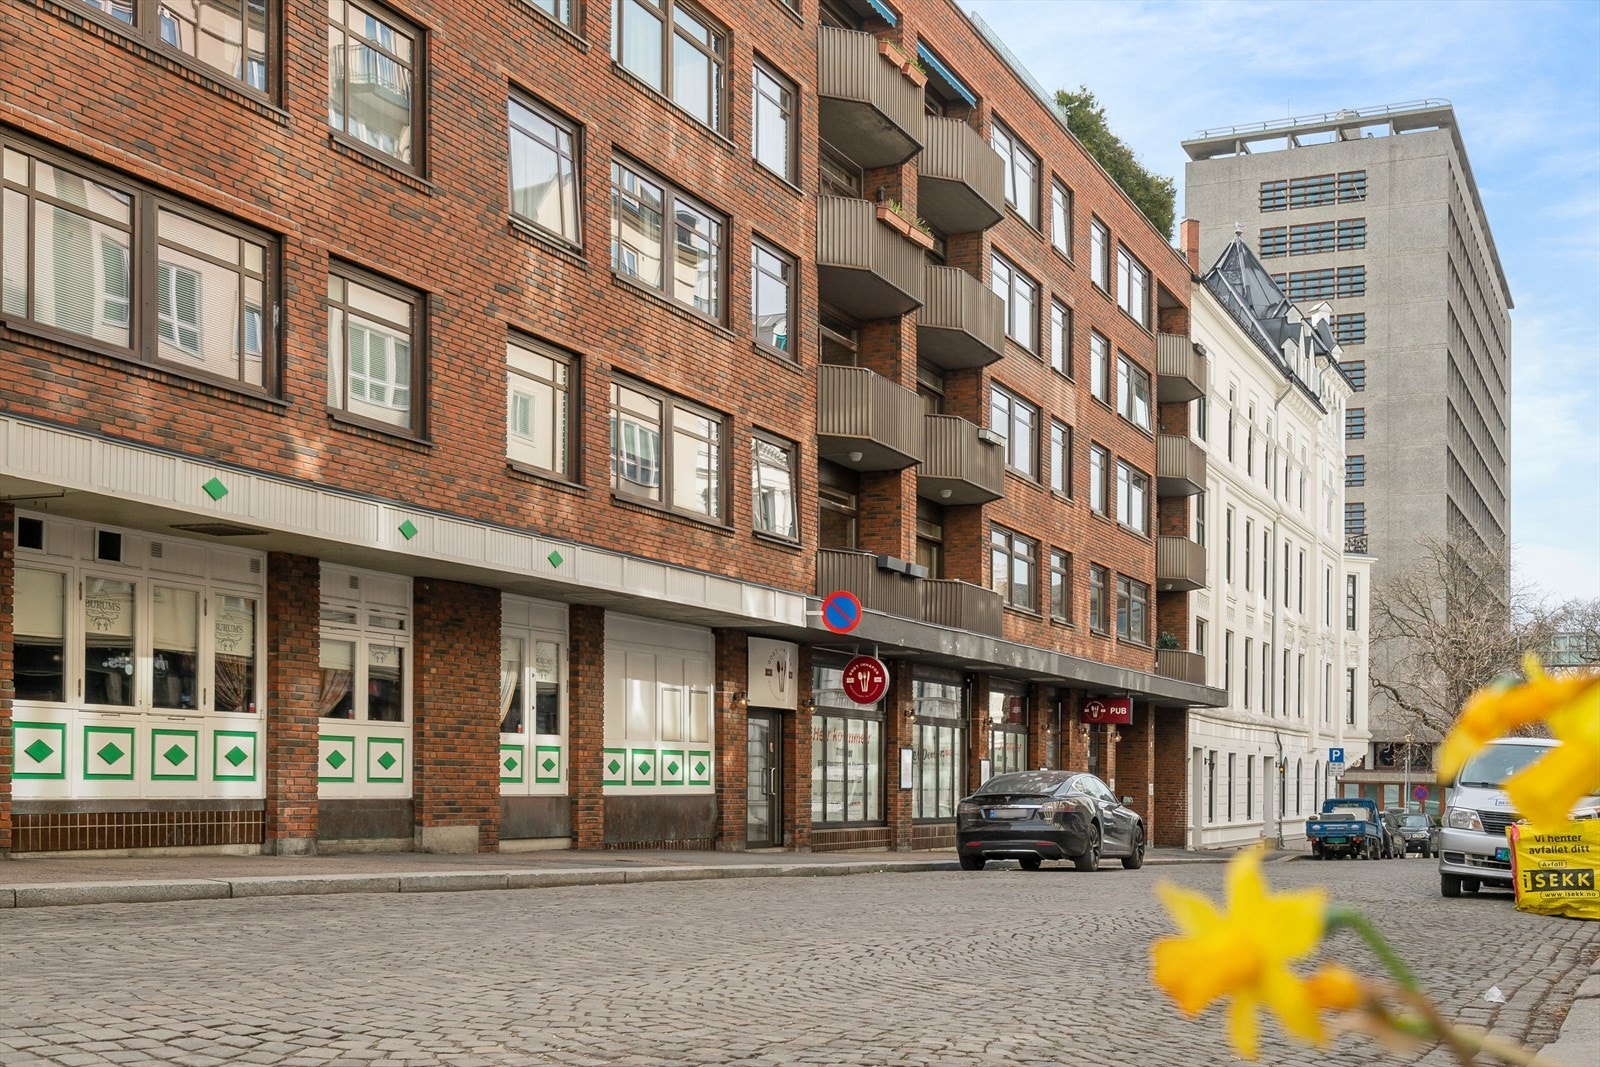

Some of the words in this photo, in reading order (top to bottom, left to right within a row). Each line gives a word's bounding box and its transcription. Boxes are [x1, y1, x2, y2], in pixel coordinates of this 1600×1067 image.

[1332, 750, 1340, 760] P
[1529, 846, 1568, 854] avfallet
[1571, 845, 1590, 853] ditt
